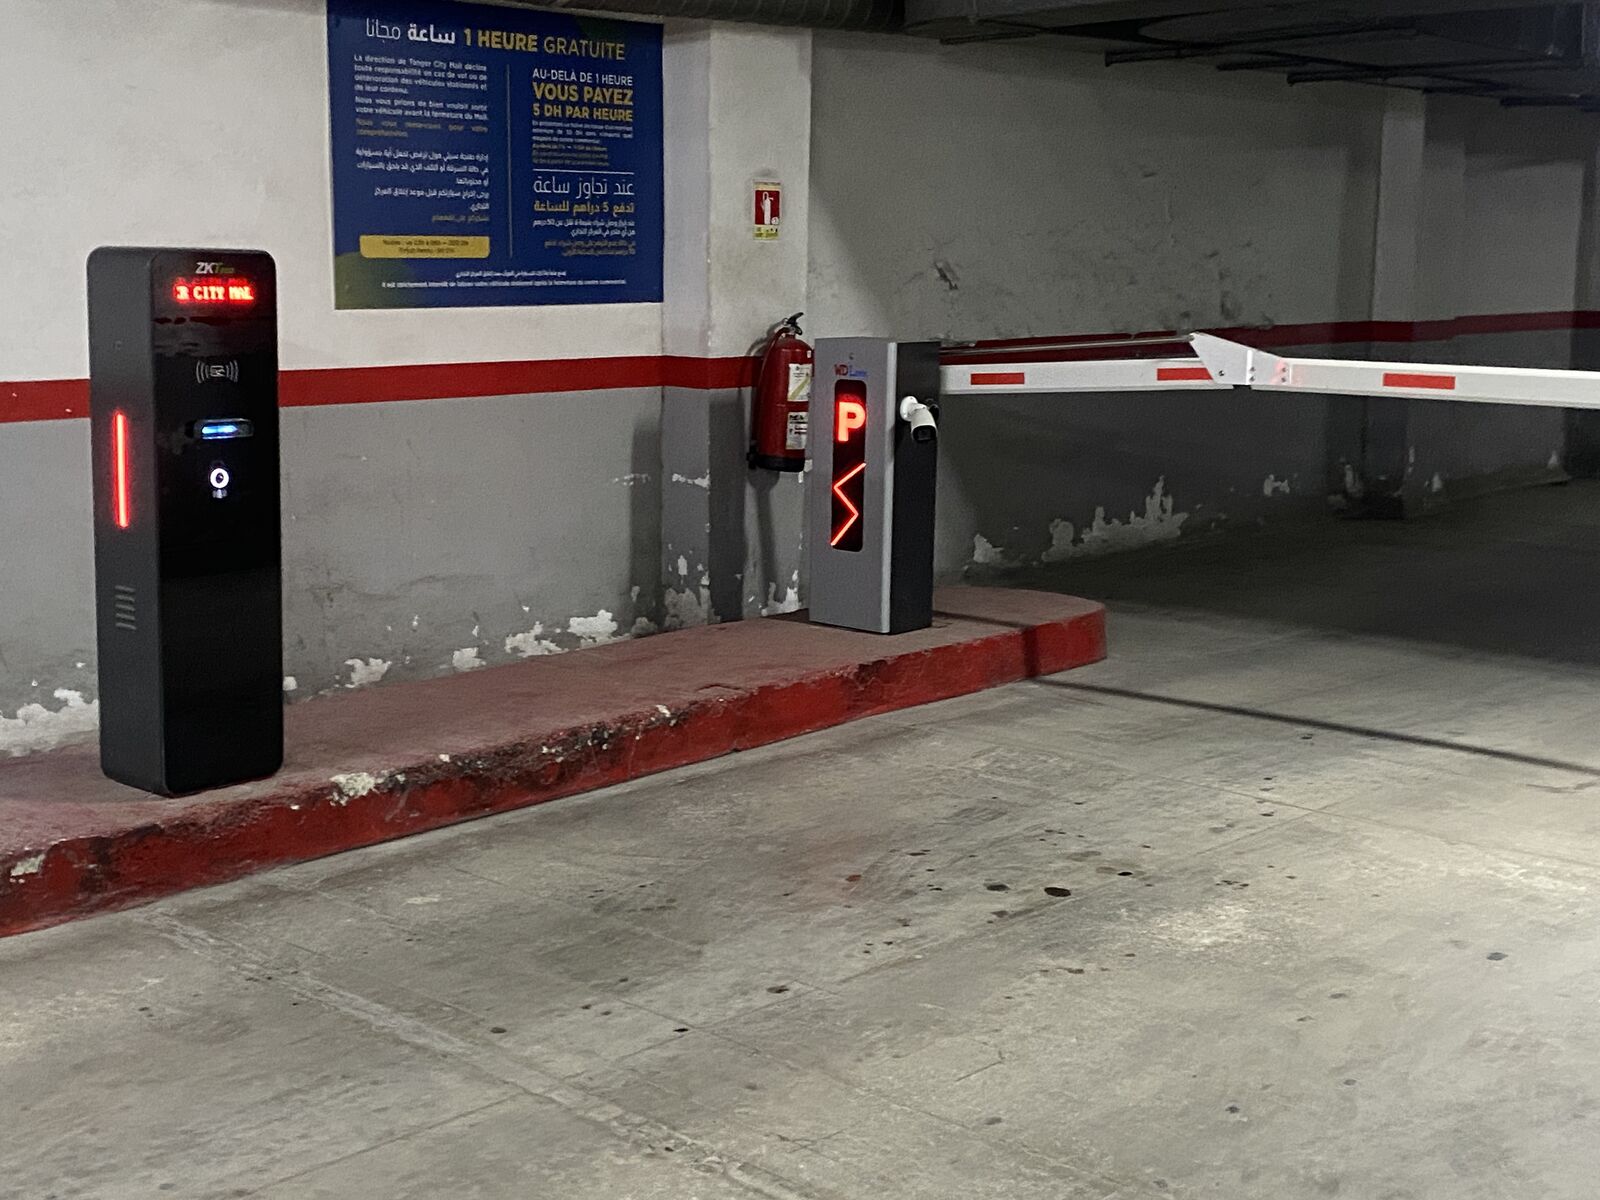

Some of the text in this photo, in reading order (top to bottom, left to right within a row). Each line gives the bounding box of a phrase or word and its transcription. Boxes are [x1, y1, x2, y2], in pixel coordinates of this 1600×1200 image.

[365, 17, 456, 45] ساعة مجانا
[464, 28, 626, 61] 1 HEURE GRATUITE
[580, 72, 593, 84] DE
[596, 73, 600, 84] 1
[601, 74, 634, 86] HEURE
[532, 82, 634, 106] VOUS PAYEZ
[532, 103, 634, 122] 5 DH PAR HEURE
[533, 176, 635, 200] عند تجاوز ساعة
[534, 200, 636, 218] تدفع 5 دراهم للساعة
[193, 284, 226, 301] CITY
[838, 401, 866, 442] P
